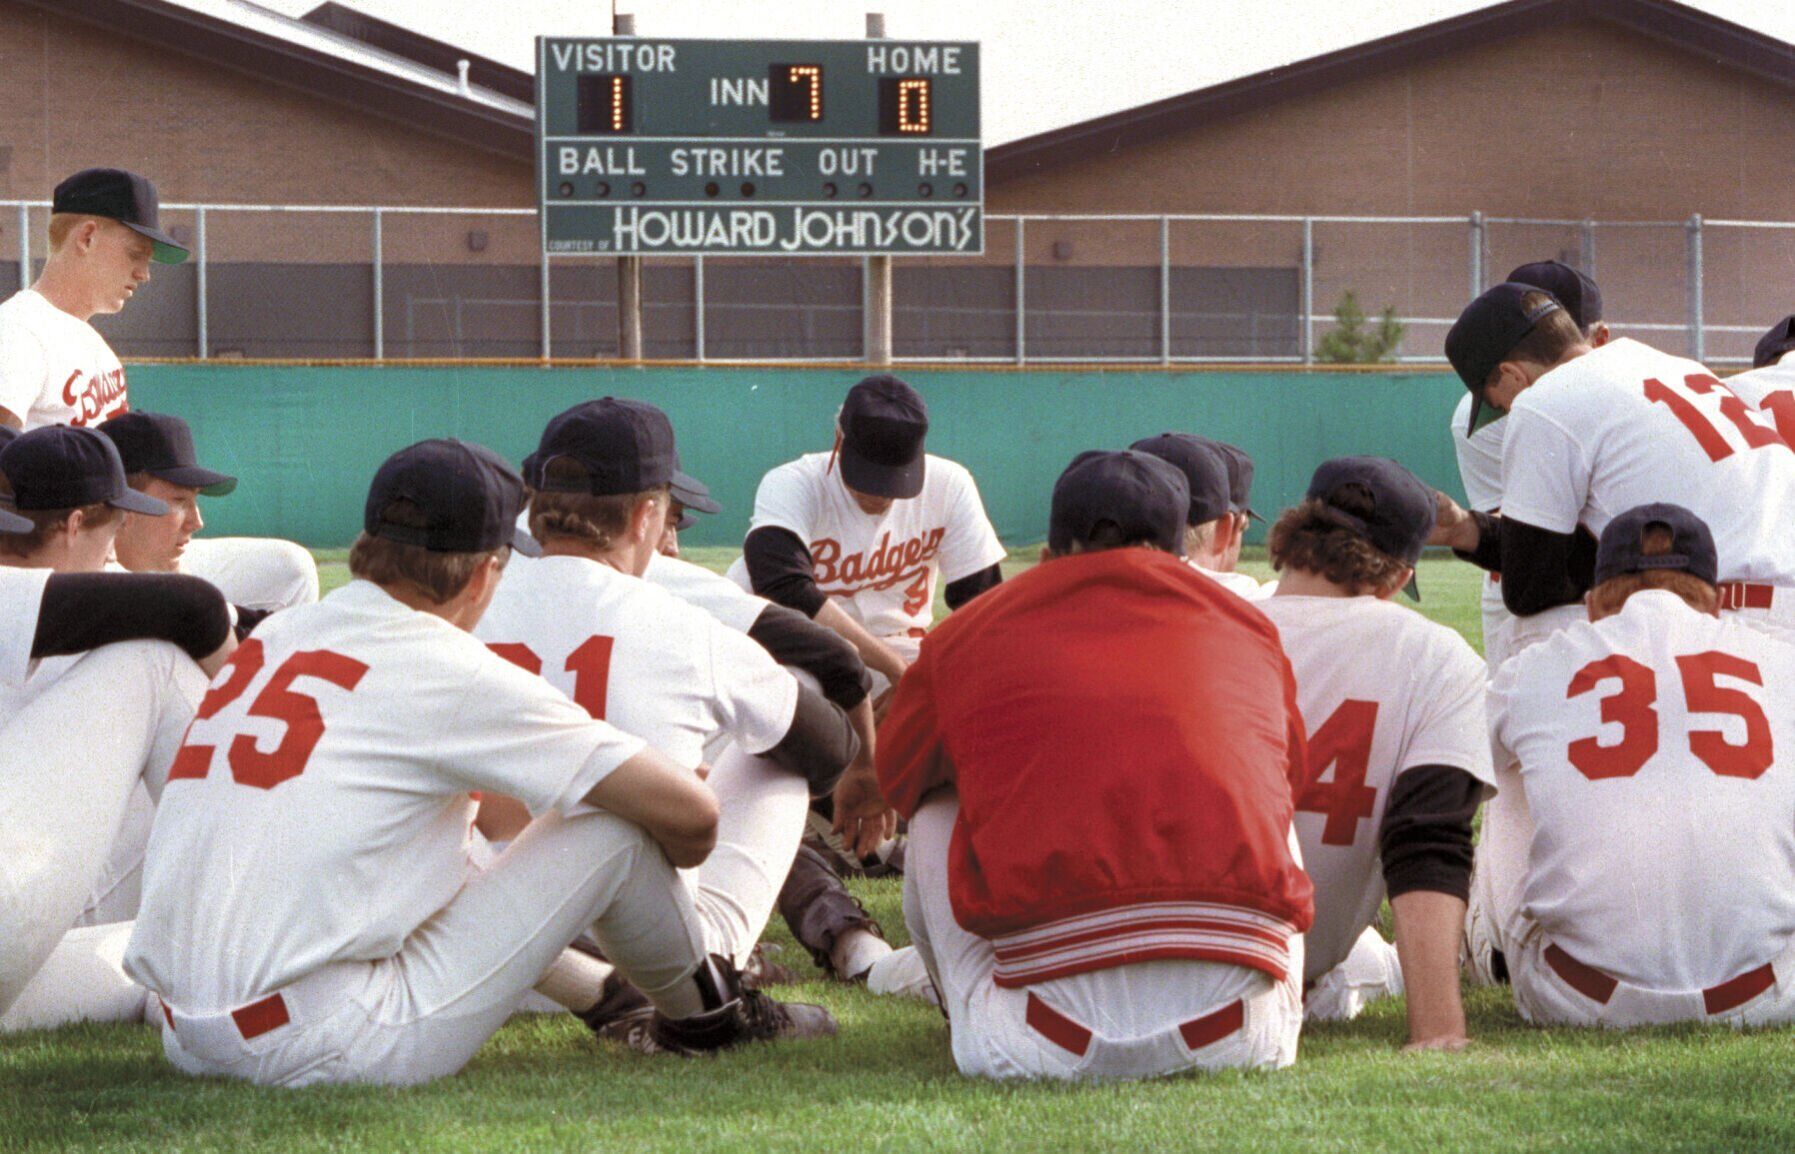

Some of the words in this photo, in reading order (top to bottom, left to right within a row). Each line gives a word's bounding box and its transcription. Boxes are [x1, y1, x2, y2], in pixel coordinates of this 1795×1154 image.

[551, 44, 676, 72] VISITOR
[867, 46, 962, 74] HOME
[612, 77, 623, 131] 1
[710, 78, 769, 106] INN
[789, 67, 820, 119] 7
[899, 80, 928, 133] 0
[559, 147, 645, 175] BALL
[671, 148, 784, 176] STRIKE
[818, 148, 878, 176] OUT
[918, 149, 967, 177] H-E
[613, 206, 776, 251] HOWARD
[1643, 373, 1792, 463] 12
[484, 634, 615, 722] 1
[168, 637, 371, 790] 25
[1566, 650, 1775, 782] 35
